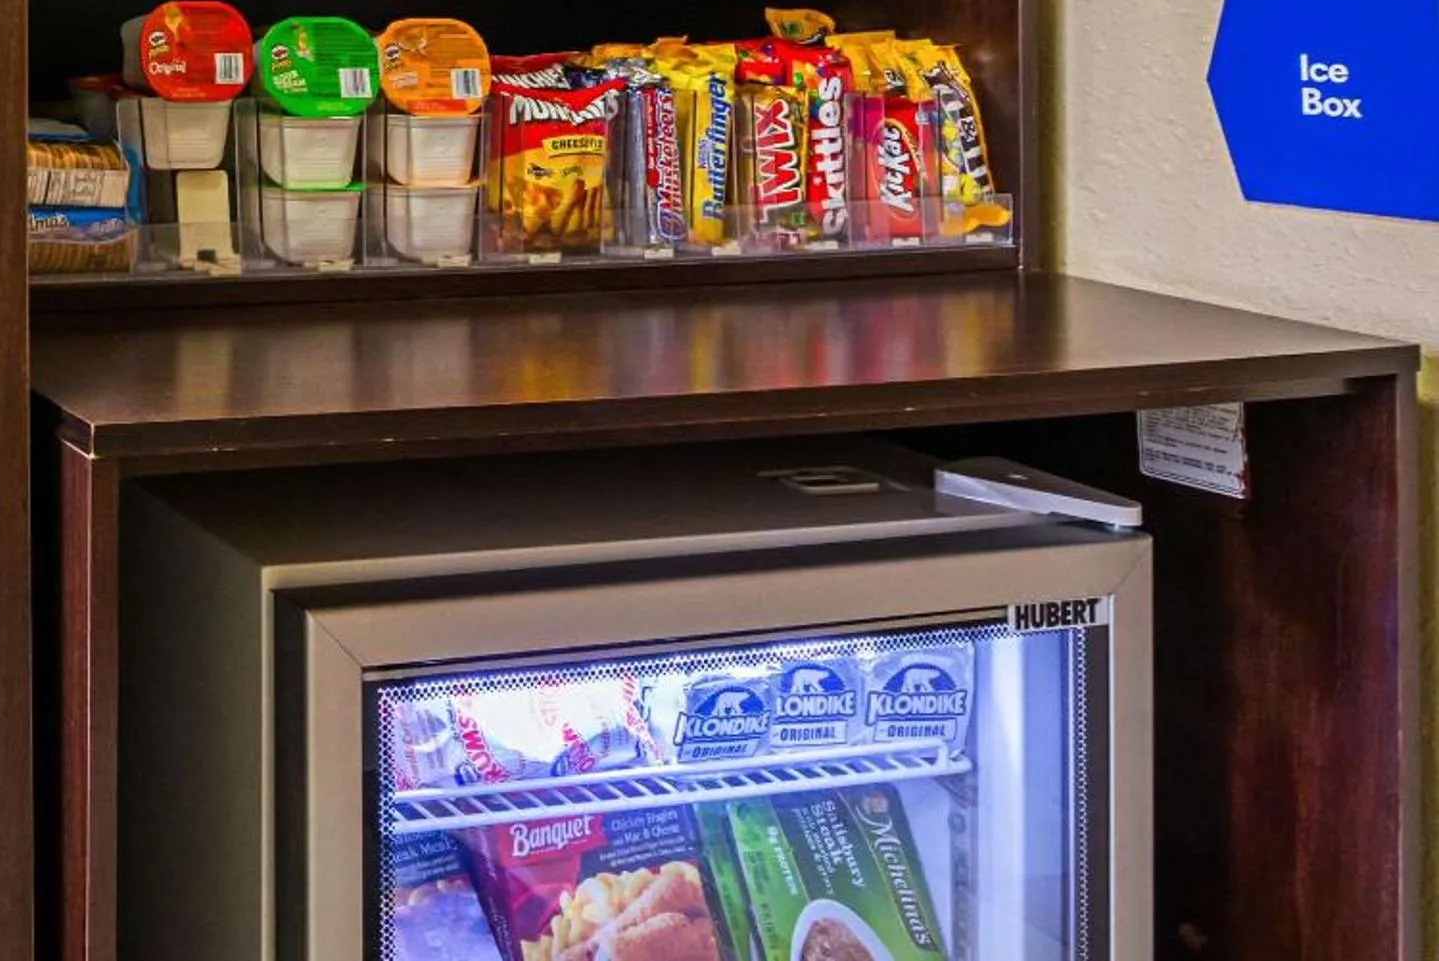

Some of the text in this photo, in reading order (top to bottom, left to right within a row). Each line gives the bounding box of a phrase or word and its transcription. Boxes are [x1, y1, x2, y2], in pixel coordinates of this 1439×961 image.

[1299, 53, 1350, 83] Ice
[1301, 87, 1363, 119] Box
[702, 72, 733, 220] Butterfinger
[1015, 597, 1101, 630] HUBERT
[775, 689, 857, 717] LONDIKE
[865, 689, 969, 726] KLONDIKE
[674, 710, 770, 745] KLONDIKE
[886, 723, 947, 738] ORIGINAL
[510, 814, 594, 857] Banquet
[810, 803, 843, 866] Steak
[822, 799, 867, 888] Salisbury
